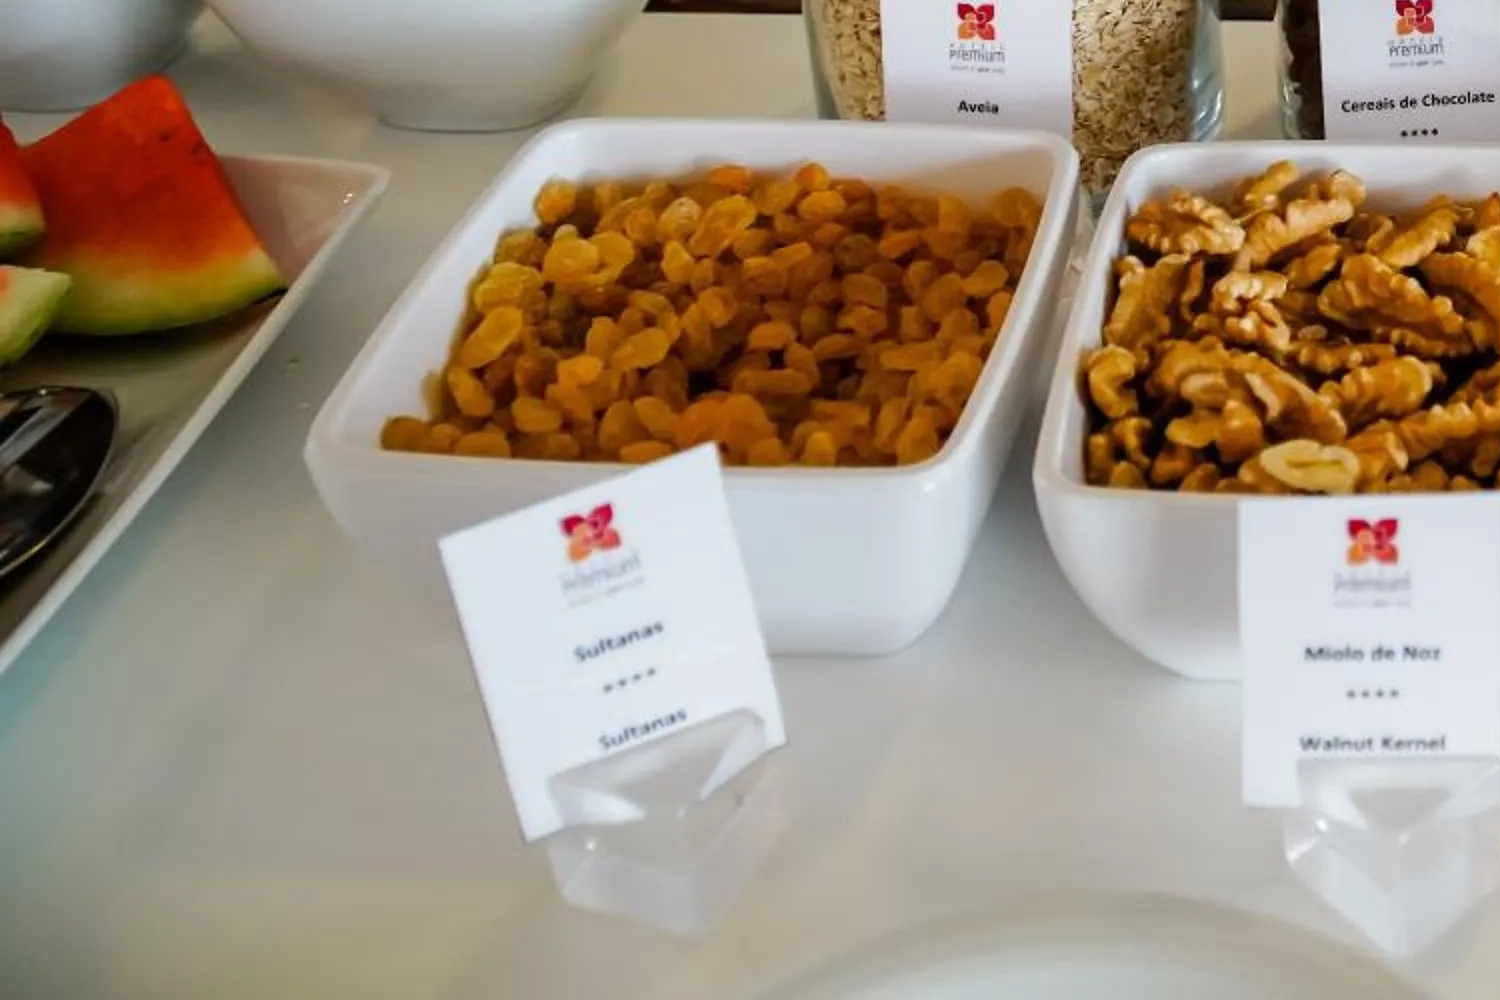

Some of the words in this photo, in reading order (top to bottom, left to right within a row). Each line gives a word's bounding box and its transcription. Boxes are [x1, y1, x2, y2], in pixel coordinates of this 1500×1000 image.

[957, 100, 1000, 115] Aveia
[1341, 96, 1396, 113] Cereais
[1400, 95, 1418, 109] de
[1422, 90, 1496, 108] Chocolate
[572, 619, 665, 664] Sultanas
[1303, 645, 1365, 662] Miolo
[1371, 645, 1396, 662] de
[1402, 645, 1442, 662] Noz
[598, 708, 688, 752] Sultanas
[1299, 736, 1374, 752] Walnut
[1381, 735, 1447, 752] Kernel
